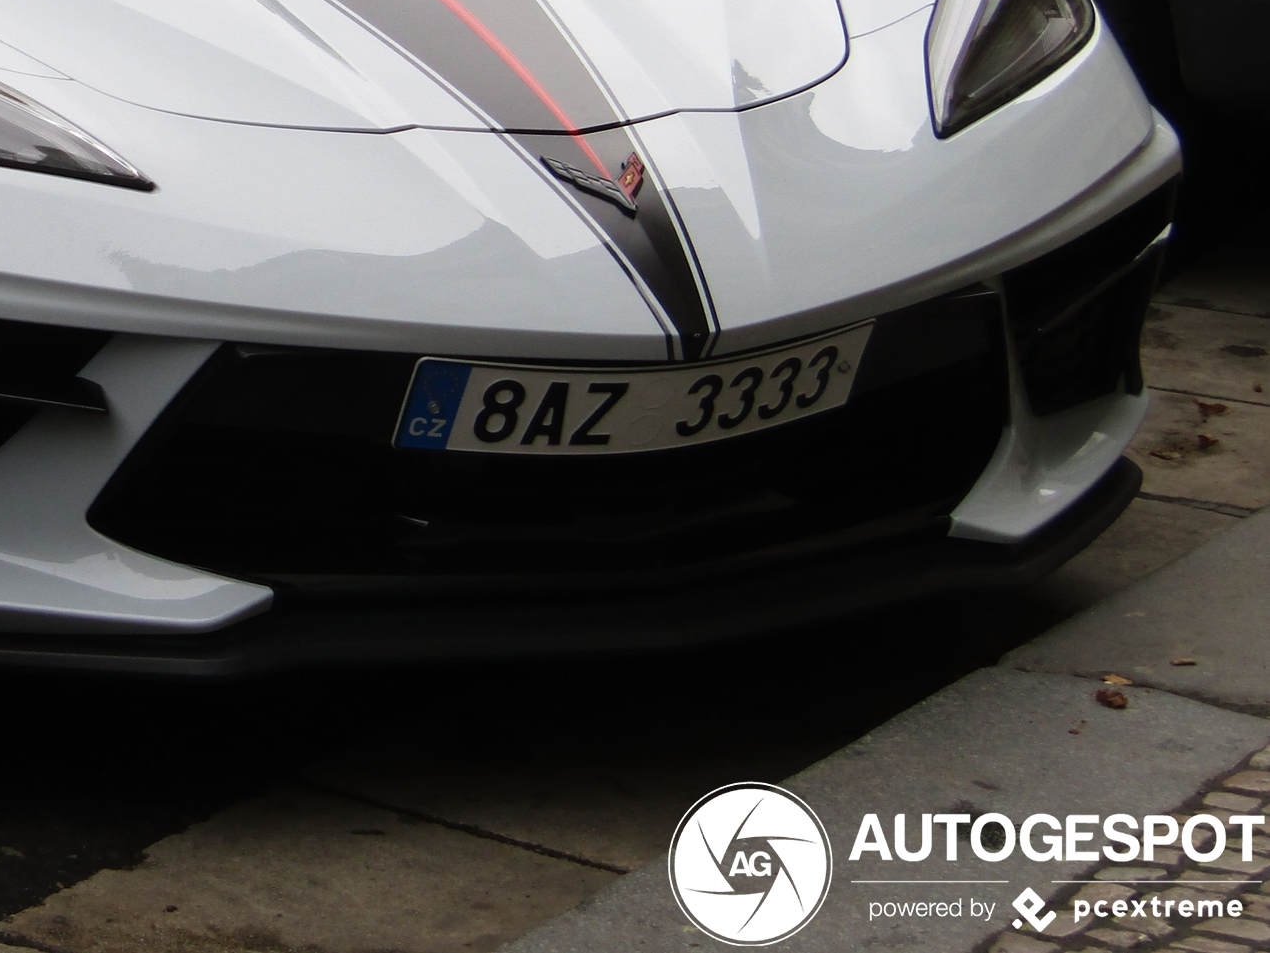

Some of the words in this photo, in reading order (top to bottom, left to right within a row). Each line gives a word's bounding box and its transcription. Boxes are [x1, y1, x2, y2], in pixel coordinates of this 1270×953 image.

[473, 379, 629, 446] 8AZ
[675, 346, 838, 436] 3333
[408, 417, 443, 438] CZ
